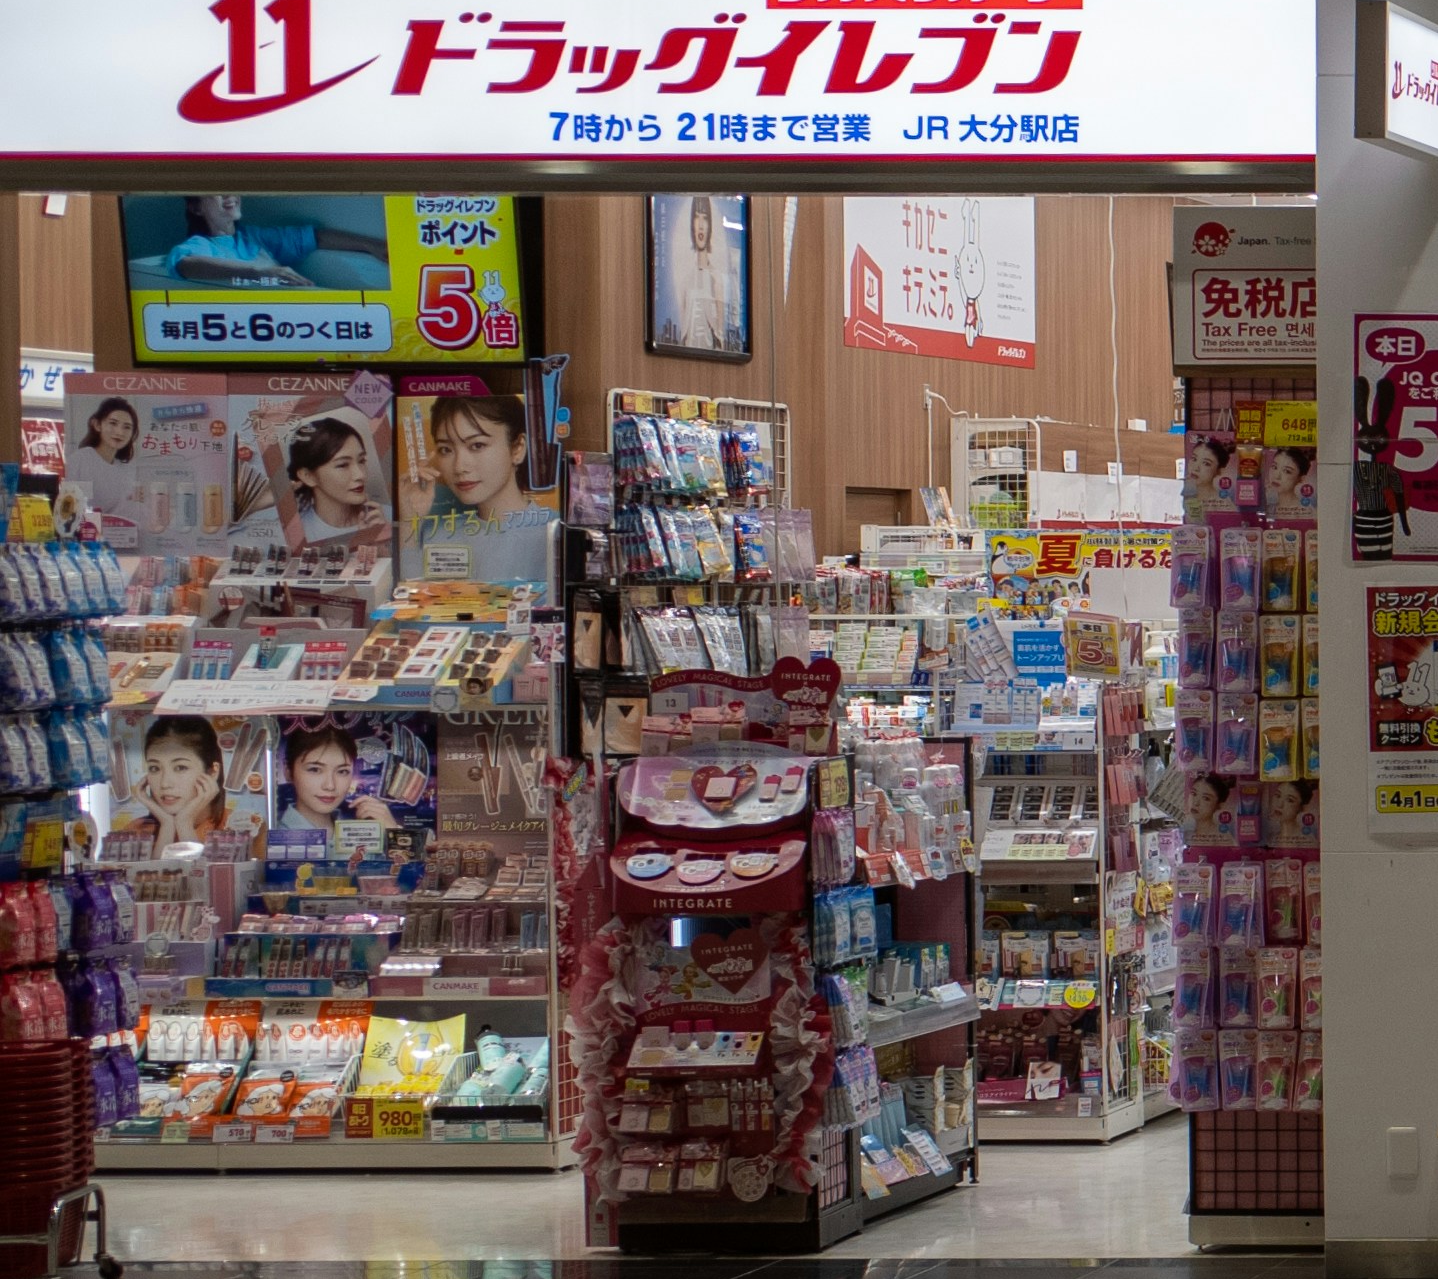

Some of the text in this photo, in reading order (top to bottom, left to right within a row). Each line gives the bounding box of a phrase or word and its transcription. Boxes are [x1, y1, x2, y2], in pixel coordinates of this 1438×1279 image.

[390, 12, 1082, 96] ドラッグイレブン
[549, 112, 1080, 143] 7時から 21時まで営業 JR 大分駅店
[415, 197, 495, 214] ドラッグイレブン
[420, 219, 497, 247] ポイント
[1237, 236, 1311, 248] Japan. Tax-free
[1200, 276, 1317, 319] 免税店
[417, 264, 520, 349] 5倍
[161, 313, 374, 342] 毎月5と6のつく日は
[1202, 322, 1232, 337] Tax
[1237, 322, 1277, 337] Free
[1202, 339, 1218, 347] The
[1219, 339, 1245, 348] prices
[1375, 336, 1416, 356] 本日
[103, 377, 187, 391] CEZANNE
[267, 377, 350, 391] CEZANNE
[1399, 371, 1424, 387] JQ
[354, 383, 382, 394] NEW
[409, 381, 472, 392] CANMAKE
[143, 434, 200, 455] おまもり
[1036, 534, 1081, 575] 夏
[1082, 623, 1102, 633] 本日
[655, 672, 765, 690] LOVELY MAGICAL STAGE
[780, 674, 831, 683] INTEGRATE
[665, 698, 677, 708] 13
[1379, 722, 1421, 734] 無料引換
[1073, 737, 1084, 745] 14
[1381, 734, 1420, 744] クーポン
[652, 898, 733, 909] INTEGRATE
[432, 981, 480, 991] CANMAKE
